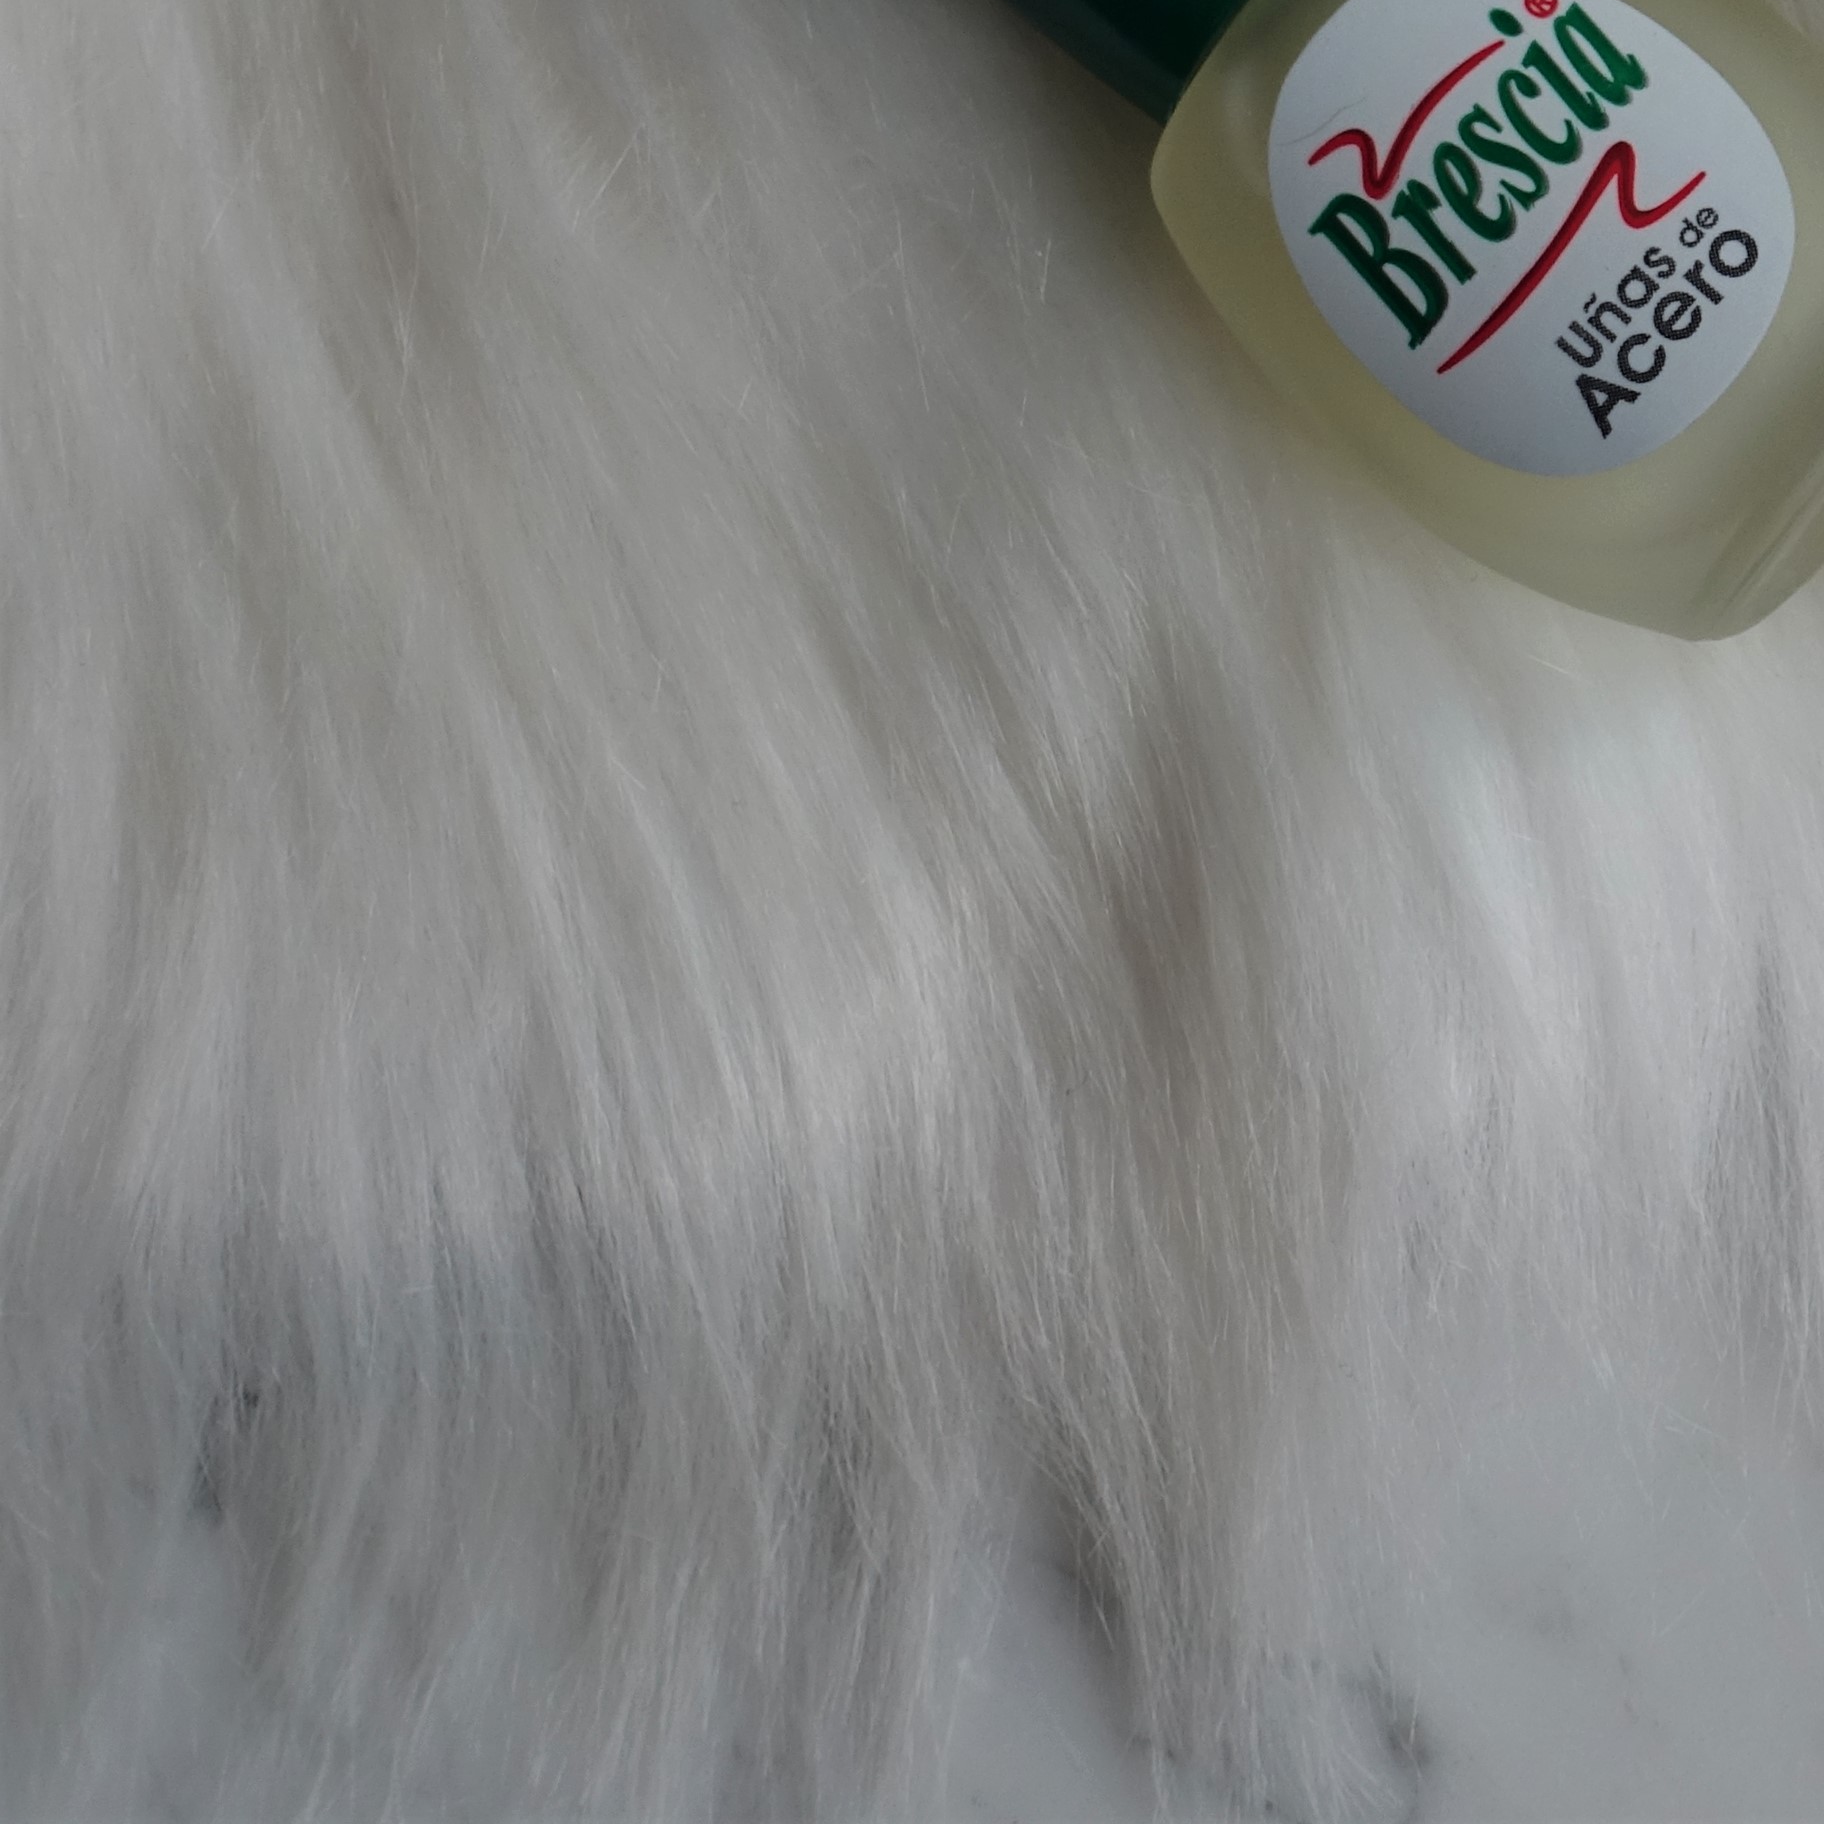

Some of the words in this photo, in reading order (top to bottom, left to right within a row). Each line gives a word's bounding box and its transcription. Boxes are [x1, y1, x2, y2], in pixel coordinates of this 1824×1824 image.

[1554, 246, 1677, 368] Uñas
[1678, 207, 1720, 248] de
[1575, 228, 1759, 439] Acero
